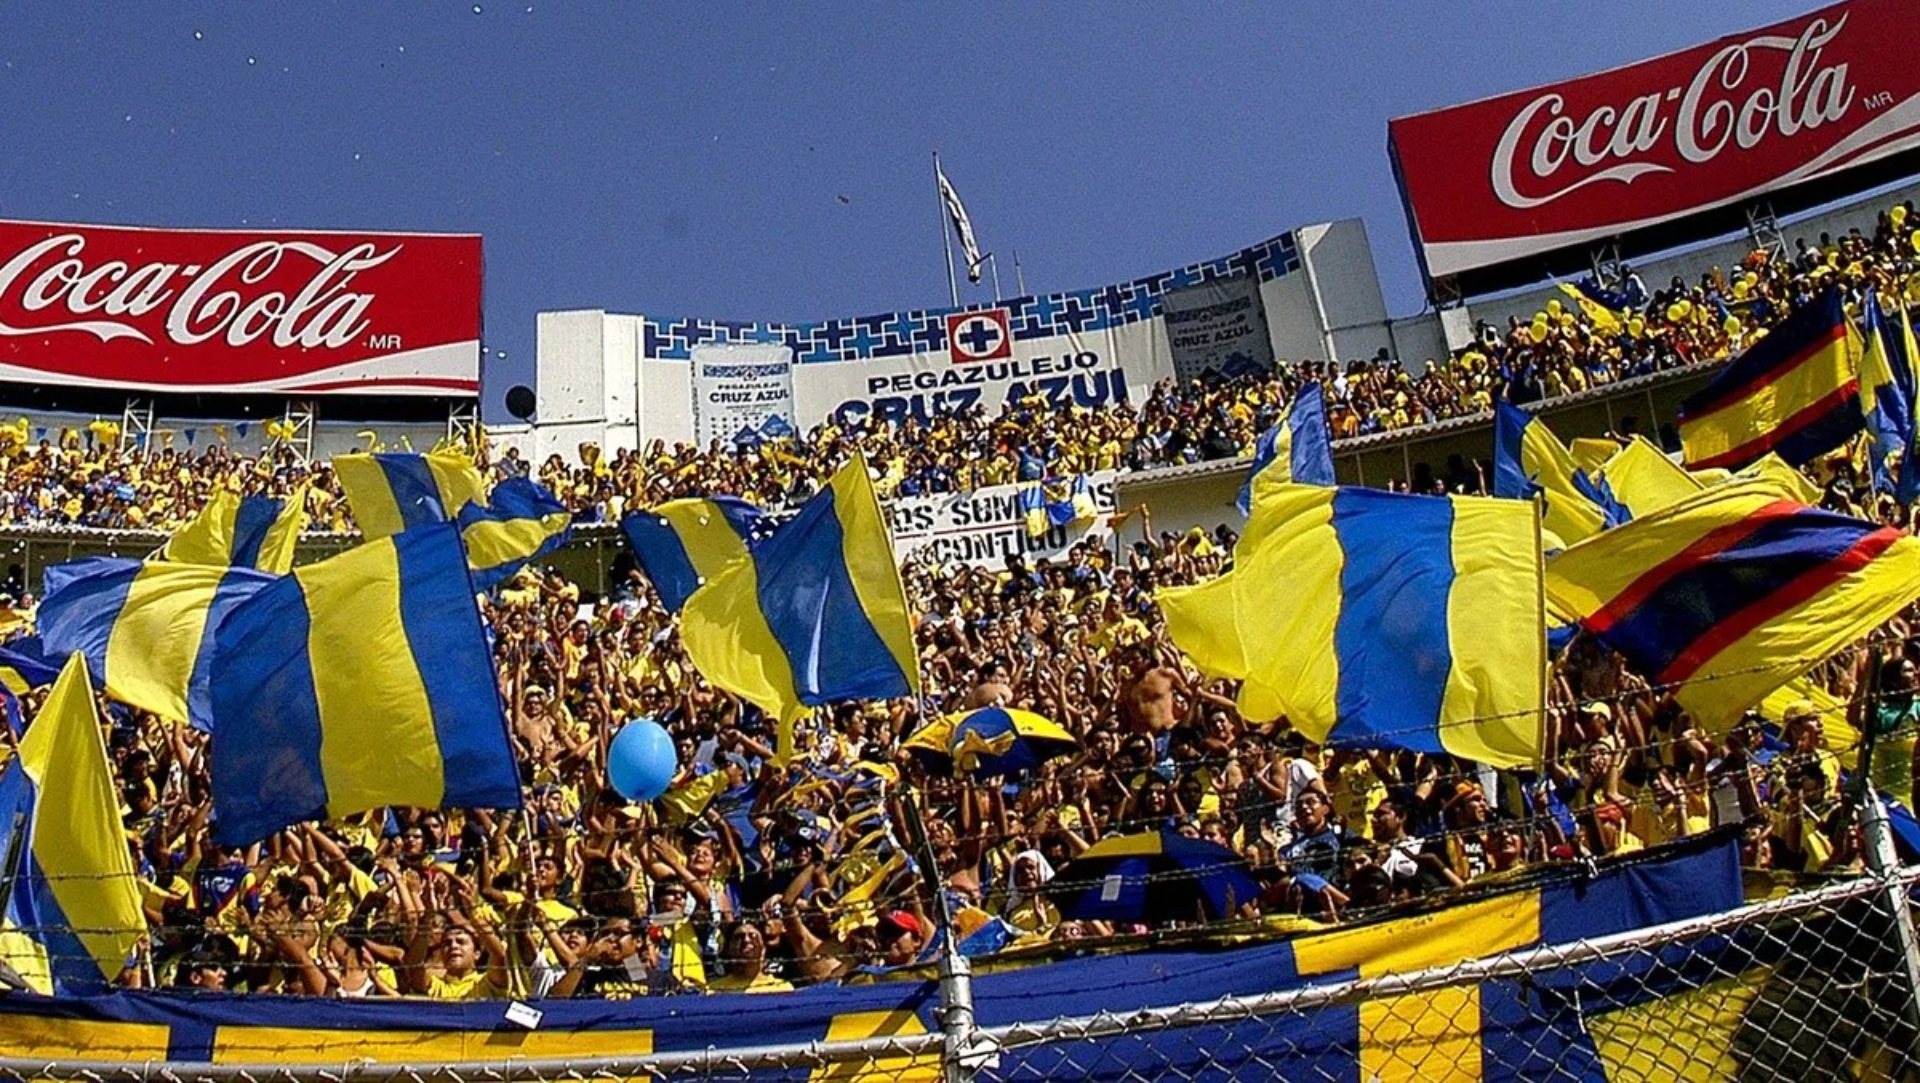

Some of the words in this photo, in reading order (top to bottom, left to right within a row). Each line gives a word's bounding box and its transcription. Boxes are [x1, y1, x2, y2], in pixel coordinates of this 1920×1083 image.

[1490, 10, 1856, 209] Coca-Cola
[1863, 91, 1894, 110] MR
[369, 334, 402, 349] MR
[1173, 333, 1210, 347] CRUZ
[1214, 324, 1254, 343] AZUL
[867, 351, 1099, 394] PEGAZULEJO
[709, 391, 752, 402] CRUZ
[756, 388, 789, 401] AZUL
